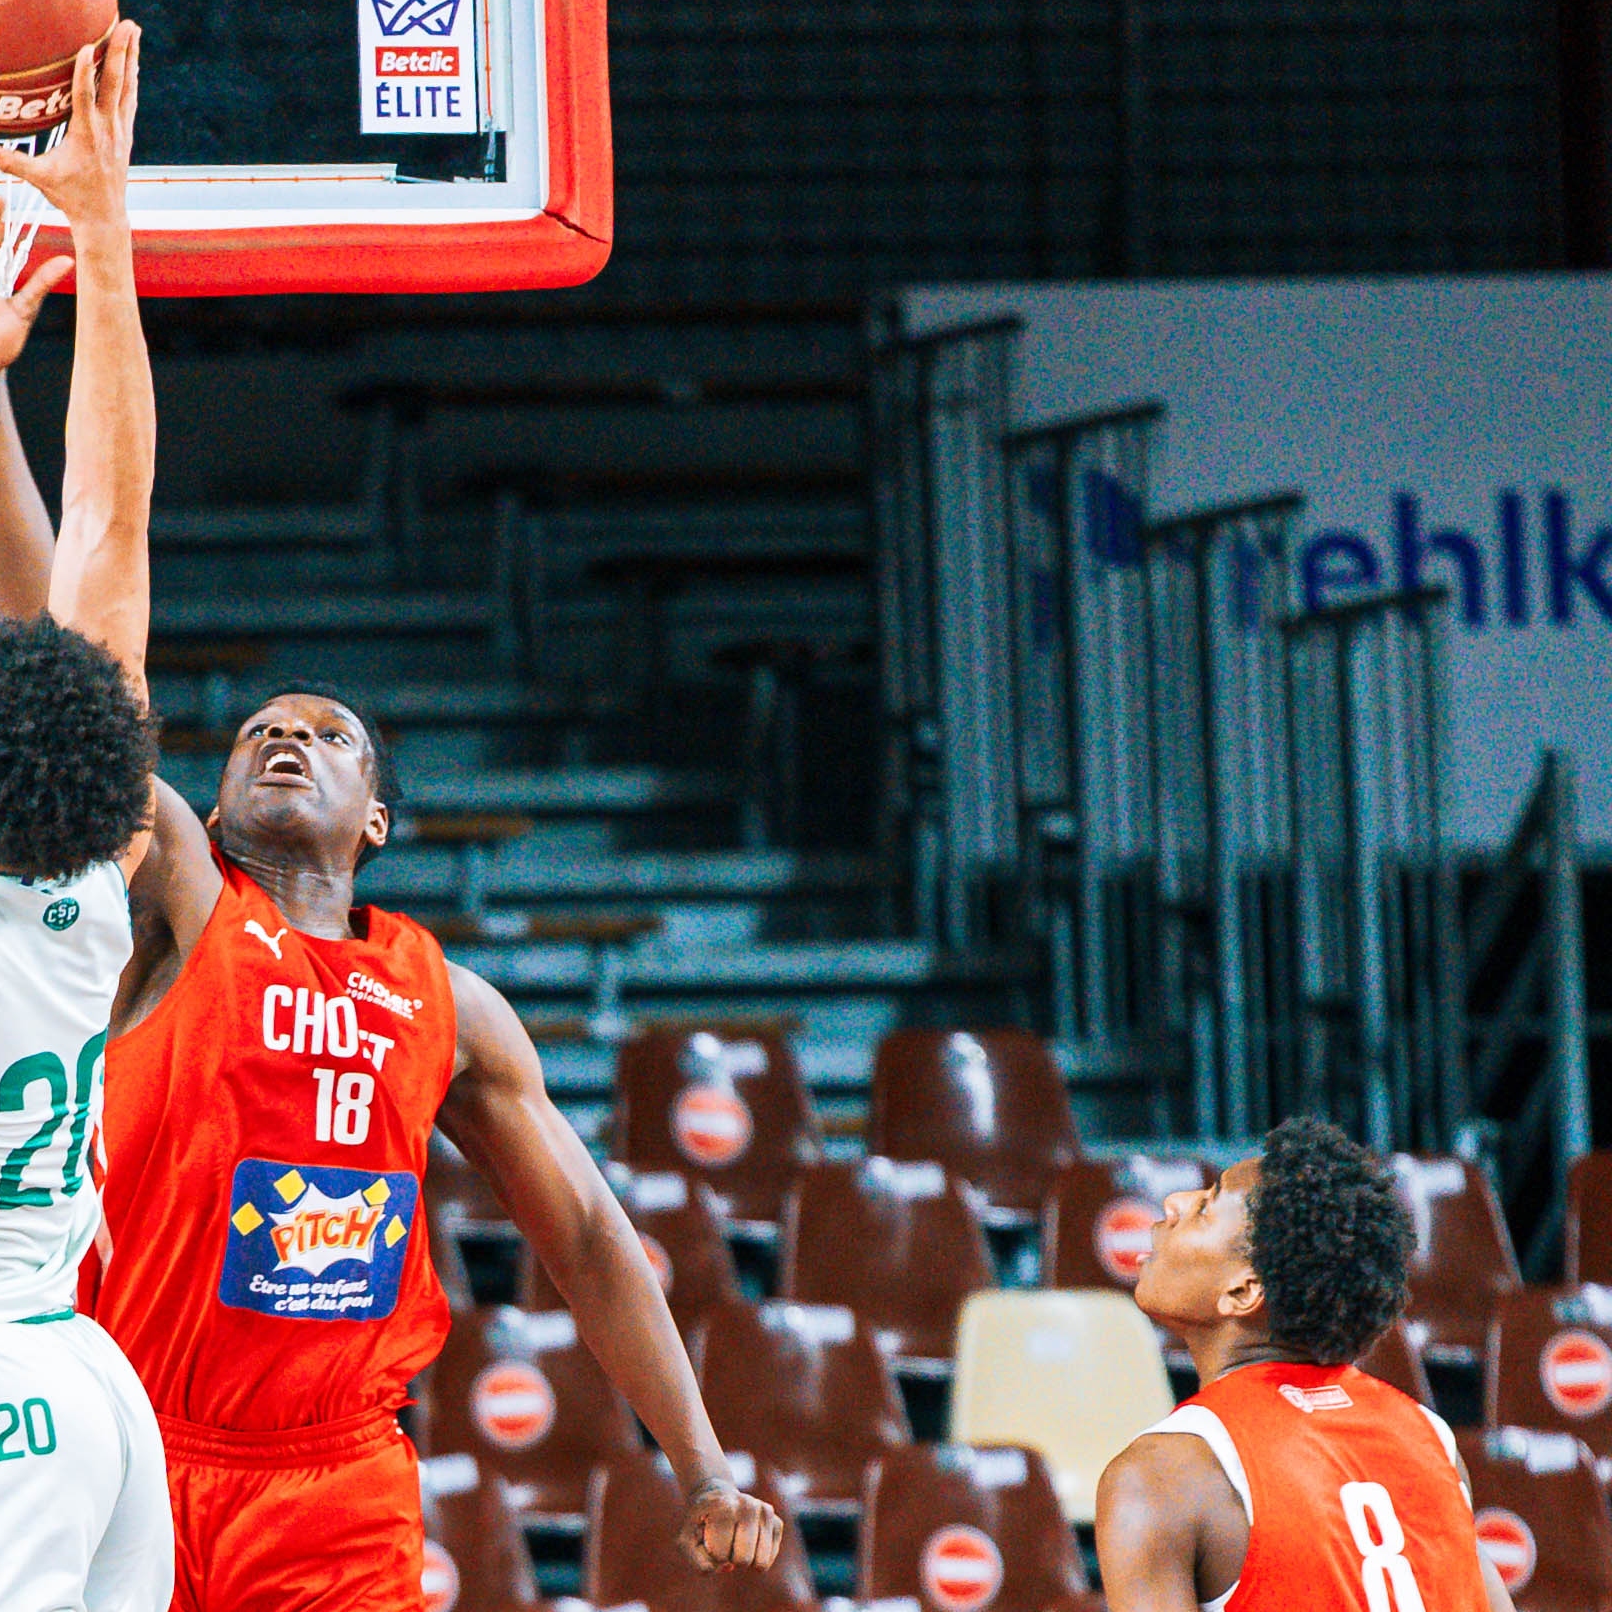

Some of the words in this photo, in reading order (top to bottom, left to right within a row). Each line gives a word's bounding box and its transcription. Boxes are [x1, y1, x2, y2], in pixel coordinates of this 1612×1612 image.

[380, 50, 455, 73] Betclic
[375, 81, 462, 118] ÉLITE
[47, 904, 77, 923] CSP
[263, 984, 395, 1072] CHOT
[312, 1068, 375, 1146] 18
